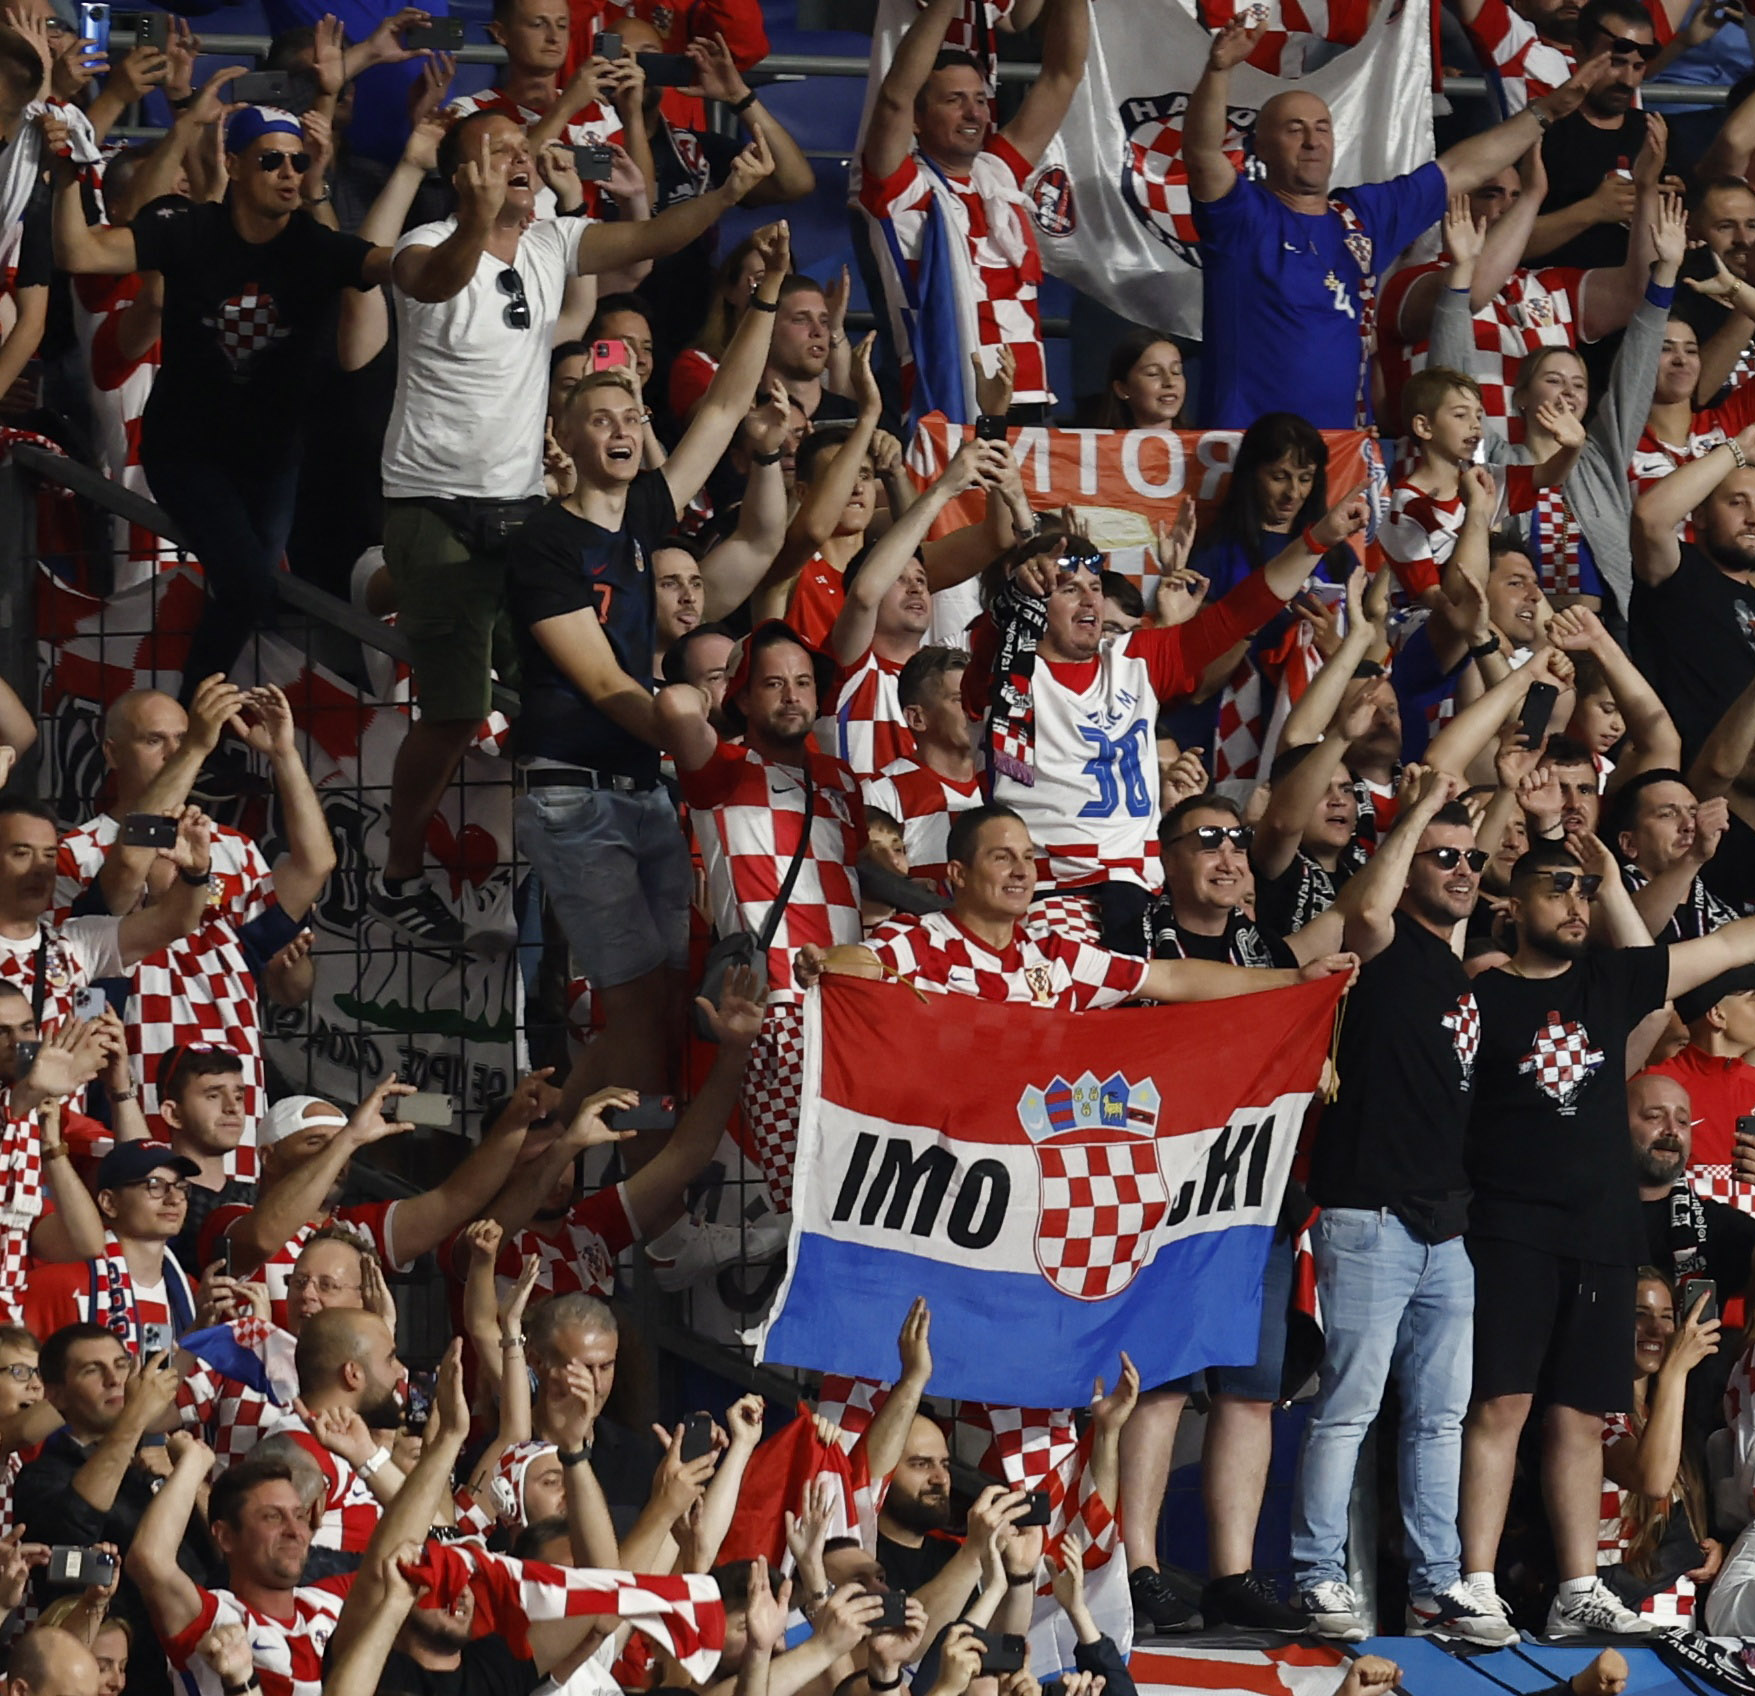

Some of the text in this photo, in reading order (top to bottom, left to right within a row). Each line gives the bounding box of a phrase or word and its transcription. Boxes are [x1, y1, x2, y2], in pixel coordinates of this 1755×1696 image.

[1334, 285, 1355, 320] 4
[593, 583, 612, 625] 7
[1076, 718, 1152, 818] 30
[831, 1131, 1011, 1250] IMO
